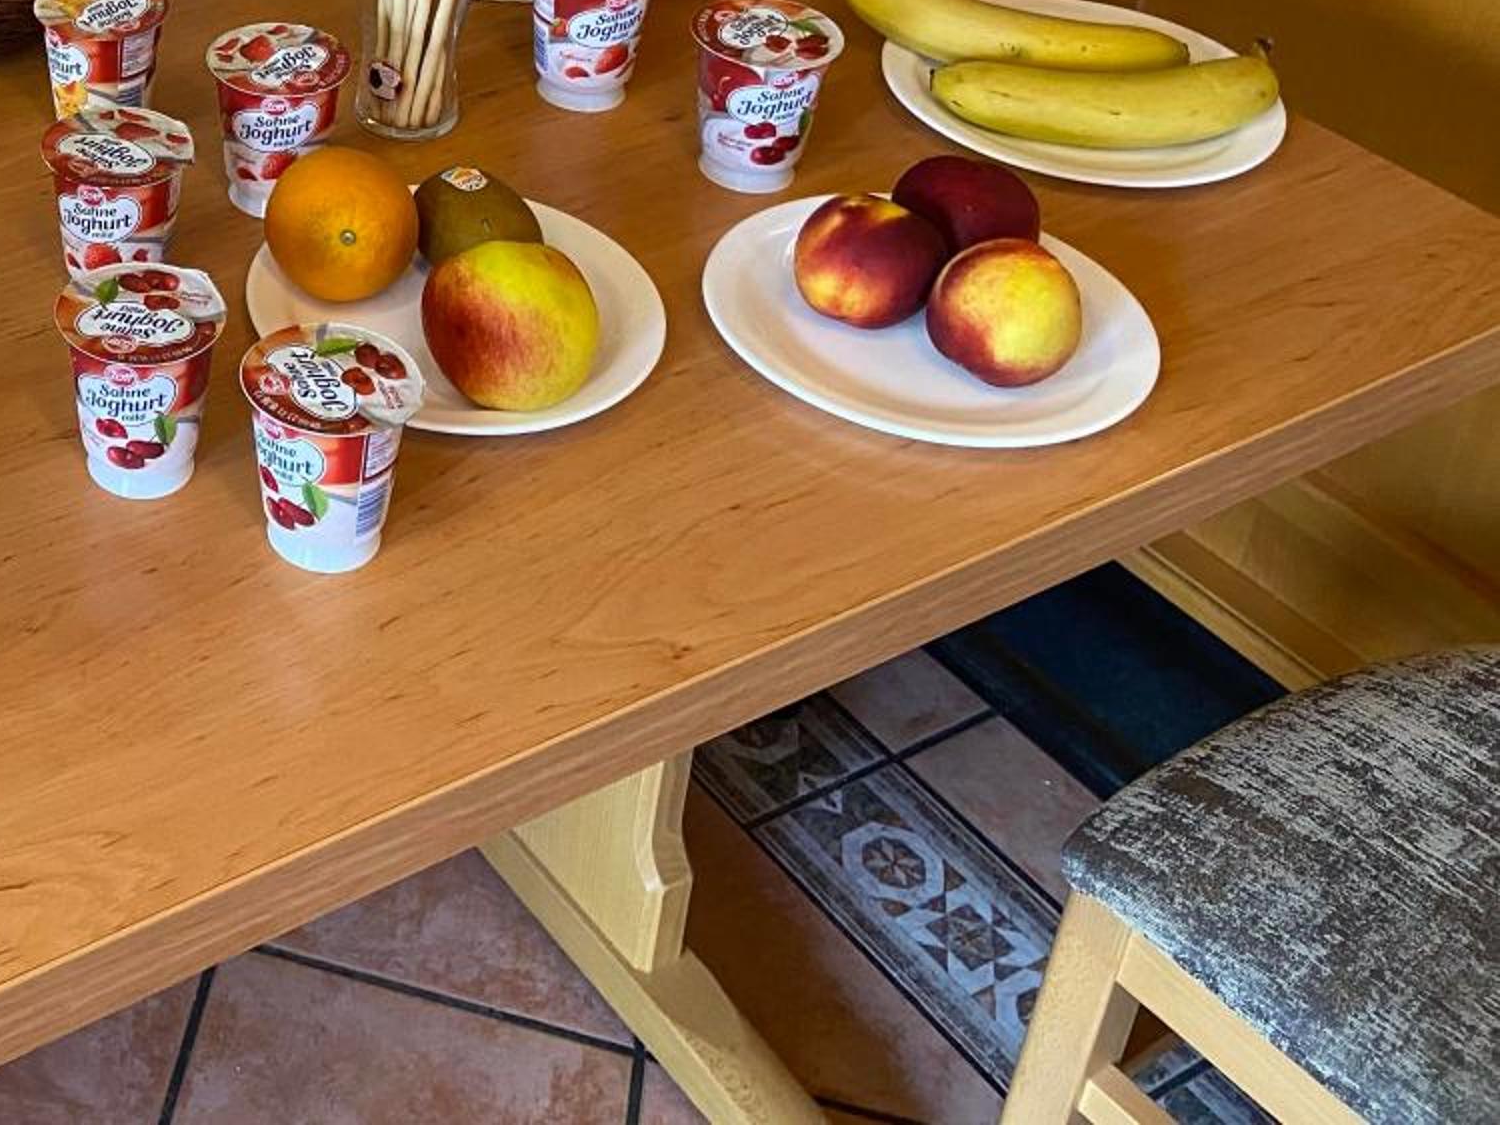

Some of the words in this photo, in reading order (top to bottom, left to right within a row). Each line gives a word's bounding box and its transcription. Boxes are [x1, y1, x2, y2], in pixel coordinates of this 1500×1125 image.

[737, 90, 813, 120] Joghurt
[239, 120, 312, 146] Joghurt
[63, 208, 133, 235] Joghurt
[92, 307, 185, 334] Joghurt
[85, 388, 164, 417] Joghurt
[100, 384, 151, 398] Sahne
